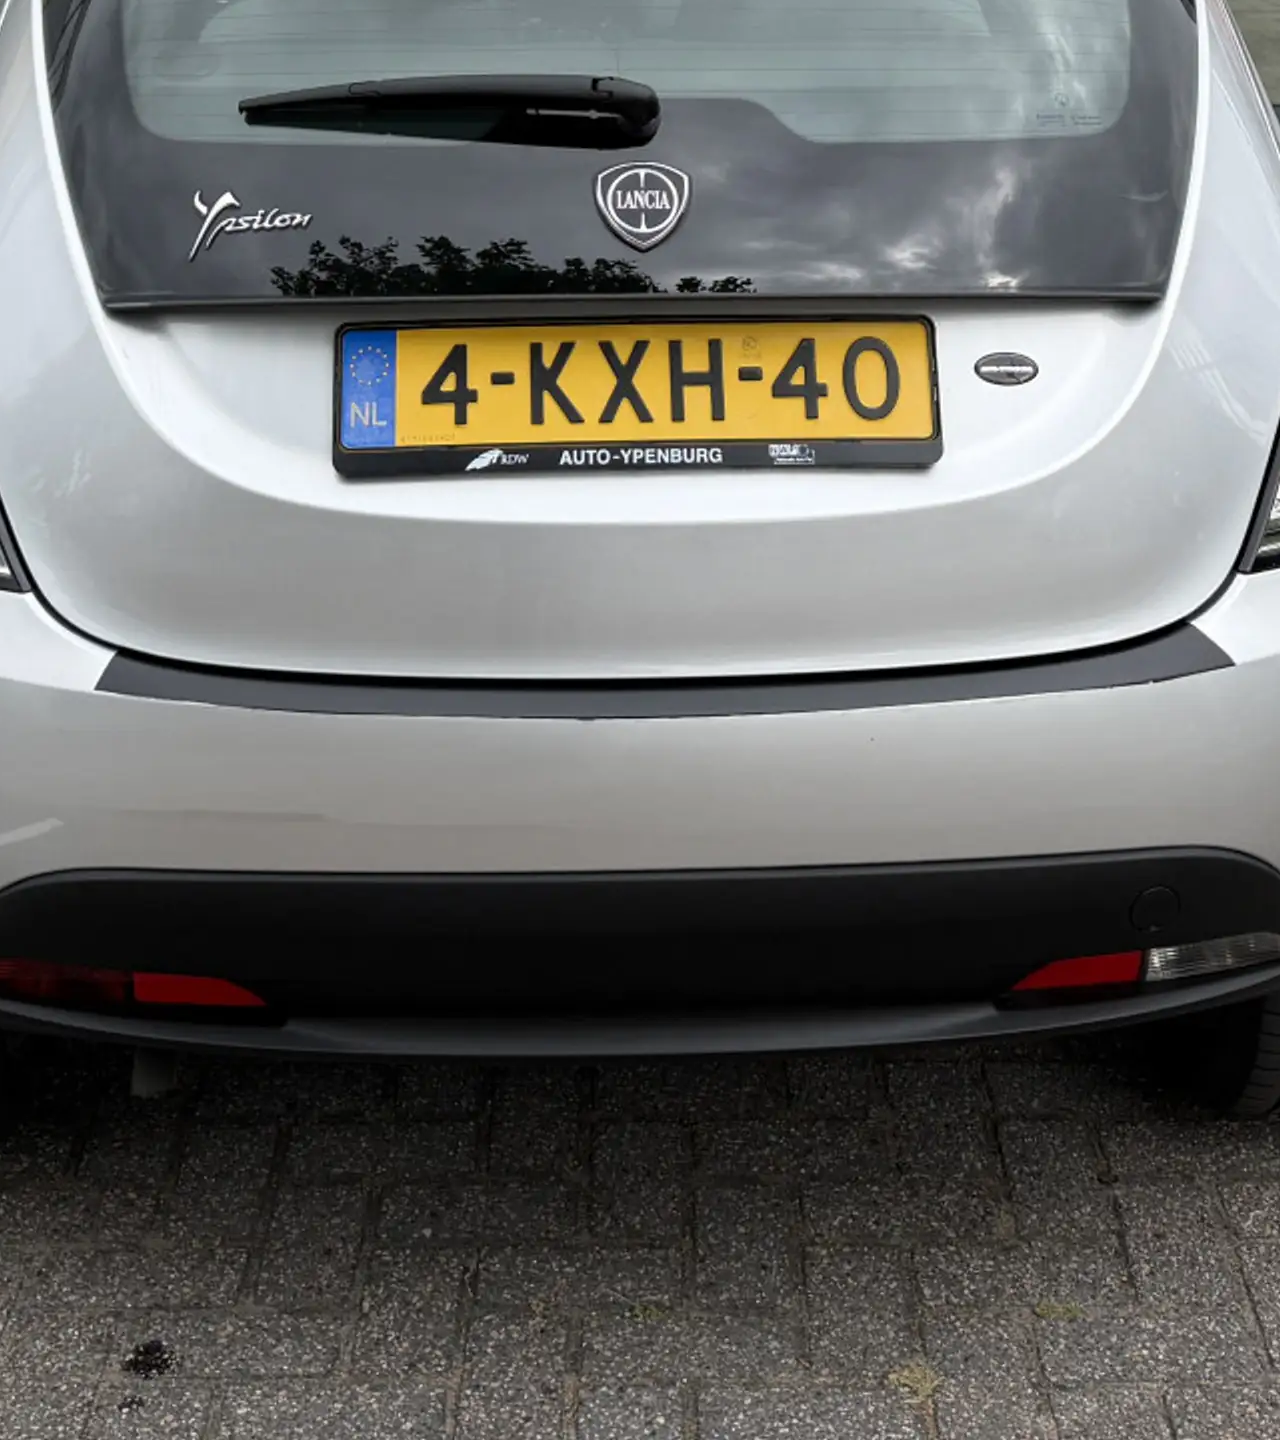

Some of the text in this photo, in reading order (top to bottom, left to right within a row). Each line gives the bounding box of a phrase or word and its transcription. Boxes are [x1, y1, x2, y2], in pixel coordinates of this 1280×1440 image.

[615, 188, 671, 211] LANCIA
[189, 189, 313, 262] Ypsilon
[421, 334, 901, 427] 4-KXH-40
[350, 401, 387, 429] NL
[559, 446, 723, 467] AUTO-YPENBURG
